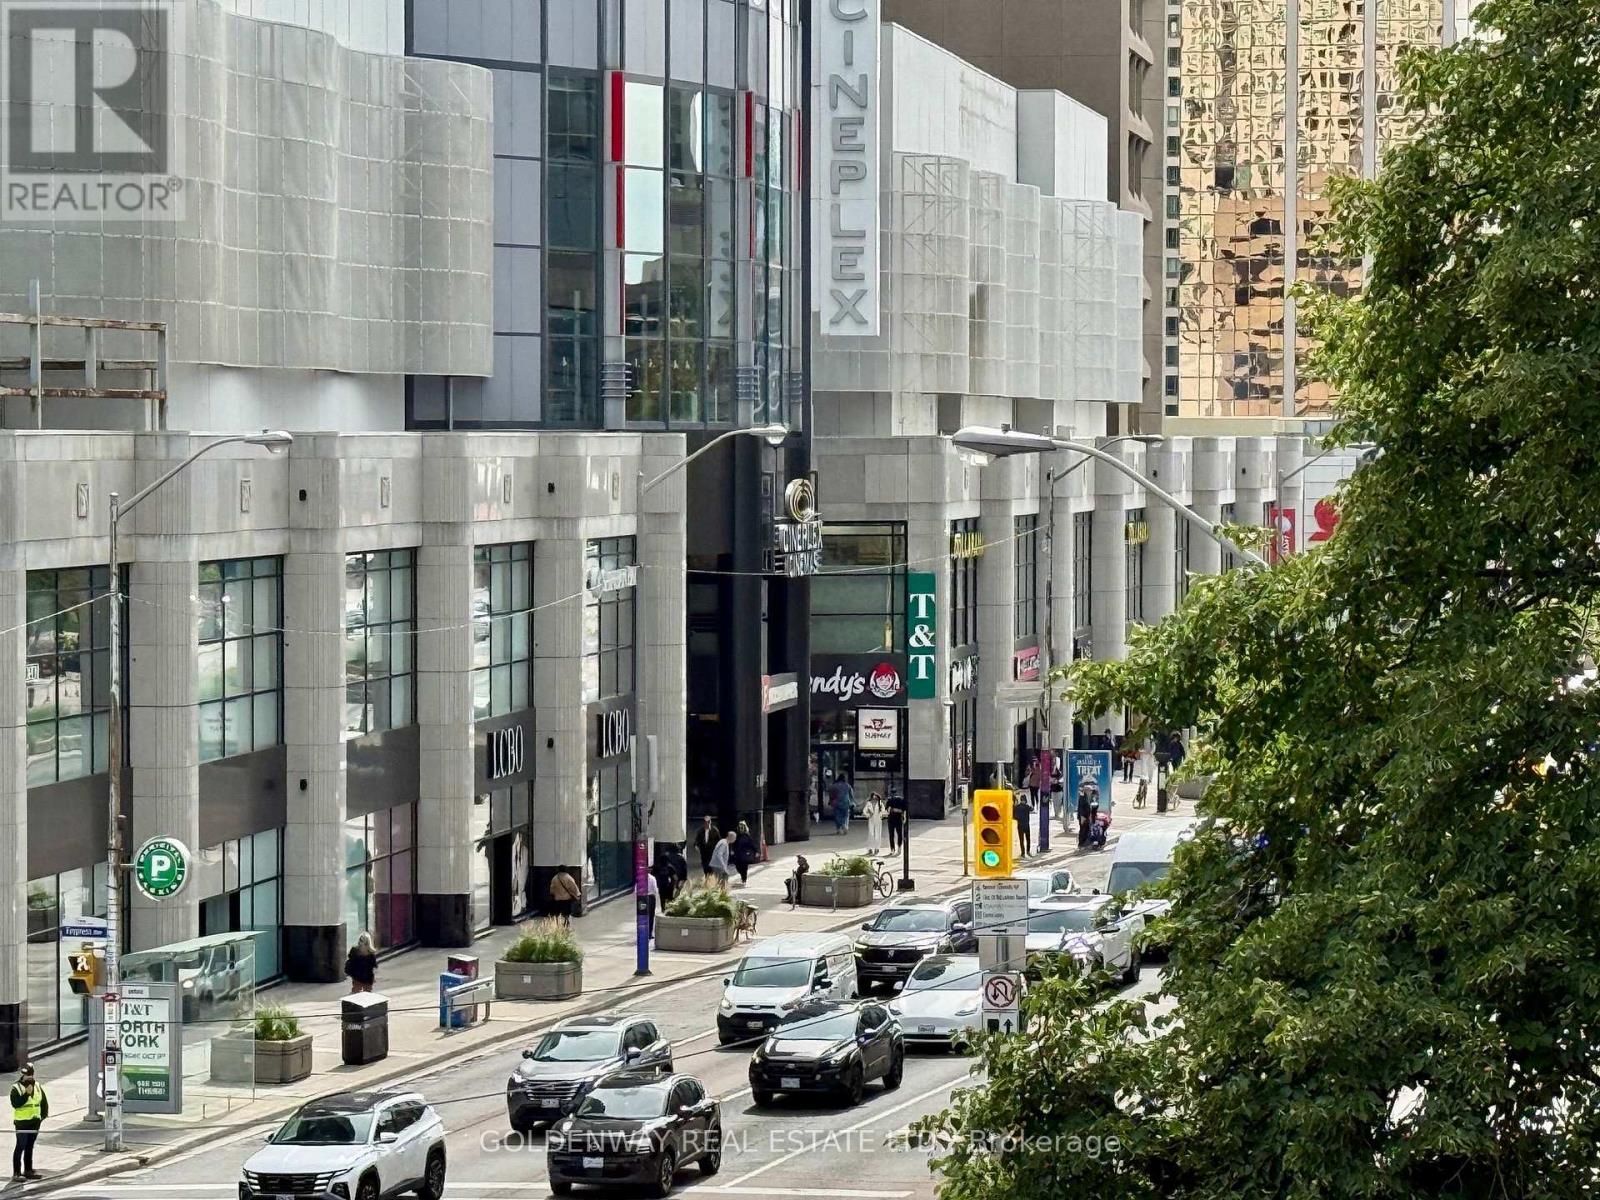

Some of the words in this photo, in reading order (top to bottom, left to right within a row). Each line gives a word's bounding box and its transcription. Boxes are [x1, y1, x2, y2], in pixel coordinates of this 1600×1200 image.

[829, 0, 868, 325] CINEPLEX
[908, 593, 935, 680] T&T
[493, 725, 524, 779] LCBO
[601, 708, 630, 759] LCBO
[151, 855, 171, 877] P
[120, 1020, 165, 1034] ORTH
